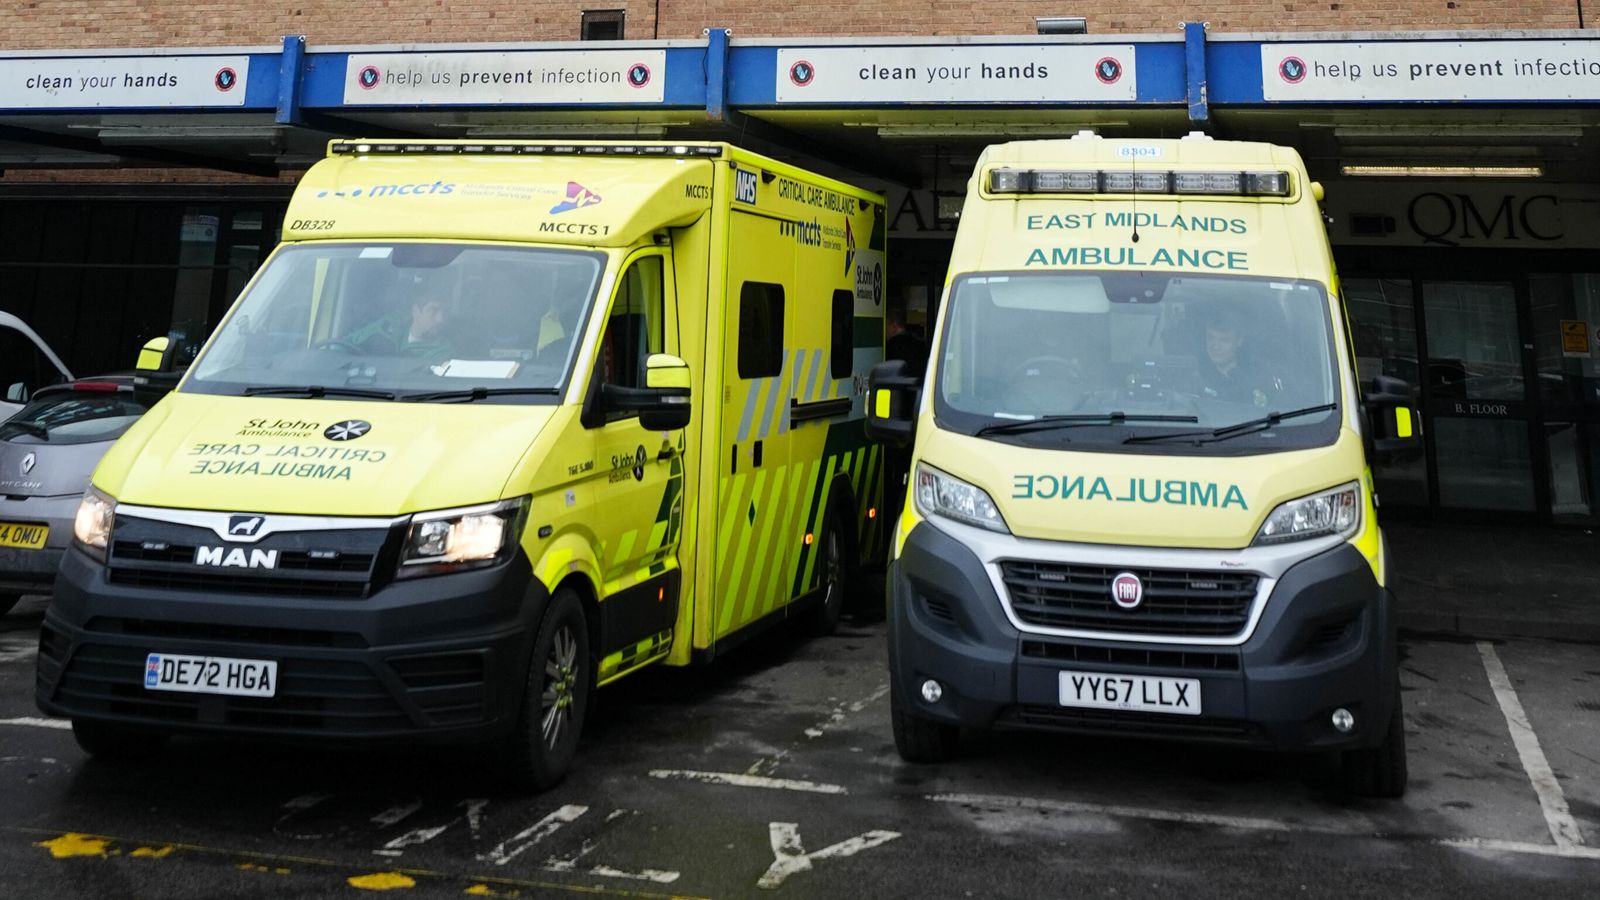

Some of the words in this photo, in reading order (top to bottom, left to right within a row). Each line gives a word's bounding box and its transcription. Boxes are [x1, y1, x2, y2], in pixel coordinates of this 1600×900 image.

[386, 69, 423, 86] help
[431, 72, 451, 85] us
[460, 69, 533, 88] prevent
[541, 67, 622, 84] infection
[859, 64, 917, 80] clean
[926, 65, 972, 84] your
[981, 61, 1049, 79] hands
[1314, 60, 1361, 79] help
[1373, 63, 1398, 77] us
[1410, 59, 1503, 81] prevent
[26, 75, 73, 89] clean
[80, 76, 117, 91] your
[124, 72, 178, 88] hands
[1121, 147, 1156, 156] 8304
[369, 181, 456, 198] mccts
[685, 184, 709, 199] MCCTS
[735, 169, 757, 205] NHS
[779, 178, 806, 204] CRITICAL
[807, 188, 822, 208] CARE
[824, 191, 855, 216] AMBULANCE
[290, 220, 336, 231] DB328
[539, 222, 598, 235] MCCTS
[602, 225, 609, 236] 1
[1027, 213, 1096, 230] EAST
[1105, 212, 1247, 234] MIDLANDS
[1407, 192, 1564, 247] QMC
[797, 217, 821, 247] mccts
[1024, 248, 1249, 270] AMBULANCE
[1470, 404, 1508, 416] FLOOR
[235, 430, 311, 438] Ambulance
[244, 418, 268, 429] St
[268, 419, 320, 431] John
[12, 526, 43, 544] OMU
[196, 546, 278, 569] MAN
[1118, 584, 1137, 600] FIAT
[160, 658, 221, 688] DE72
[226, 665, 271, 691] HGA
[1071, 675, 1134, 703] YY67
[1142, 680, 1190, 707] LLX
